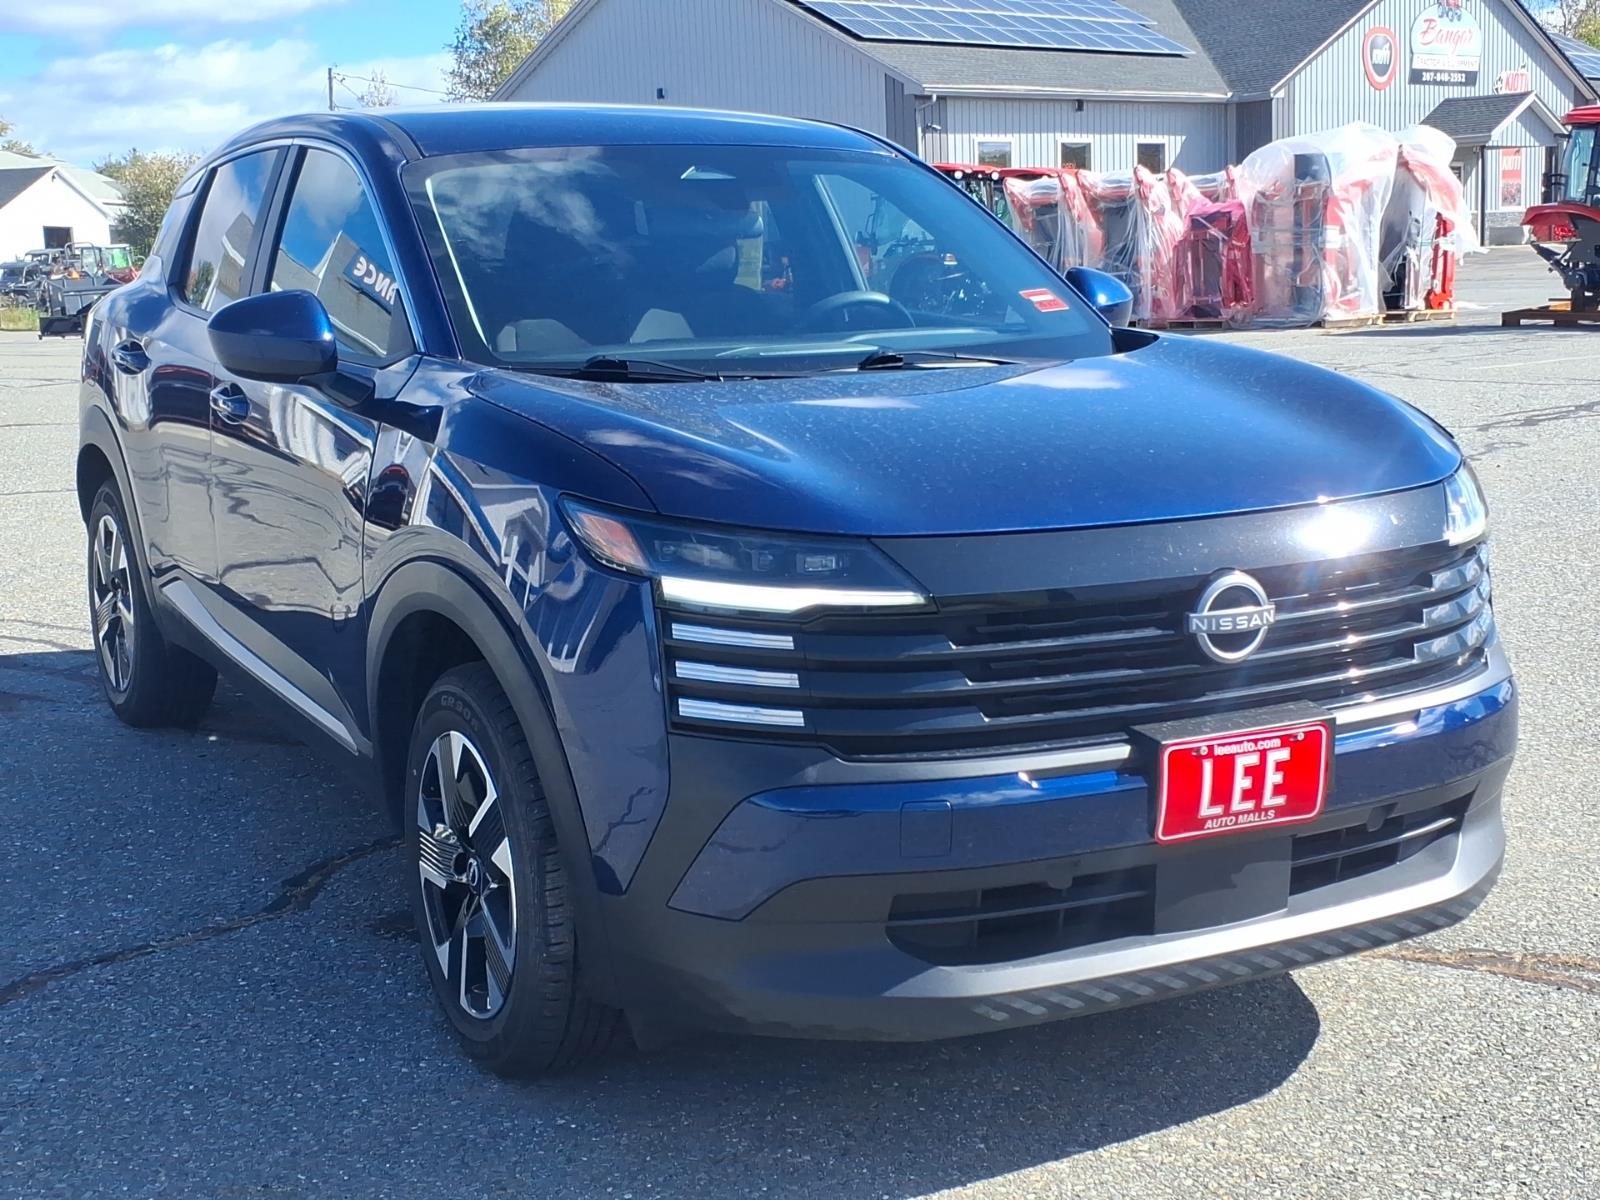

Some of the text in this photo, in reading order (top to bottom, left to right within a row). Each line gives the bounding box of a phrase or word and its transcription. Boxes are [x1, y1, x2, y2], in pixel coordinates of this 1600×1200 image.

[1420, 18, 1474, 54] Bangor
[1192, 609, 1275, 631] NISSAN
[1214, 737, 1282, 756] leeauto.com
[1198, 747, 1291, 819] LEE
[1204, 810, 1276, 829] AUTO MALLS
